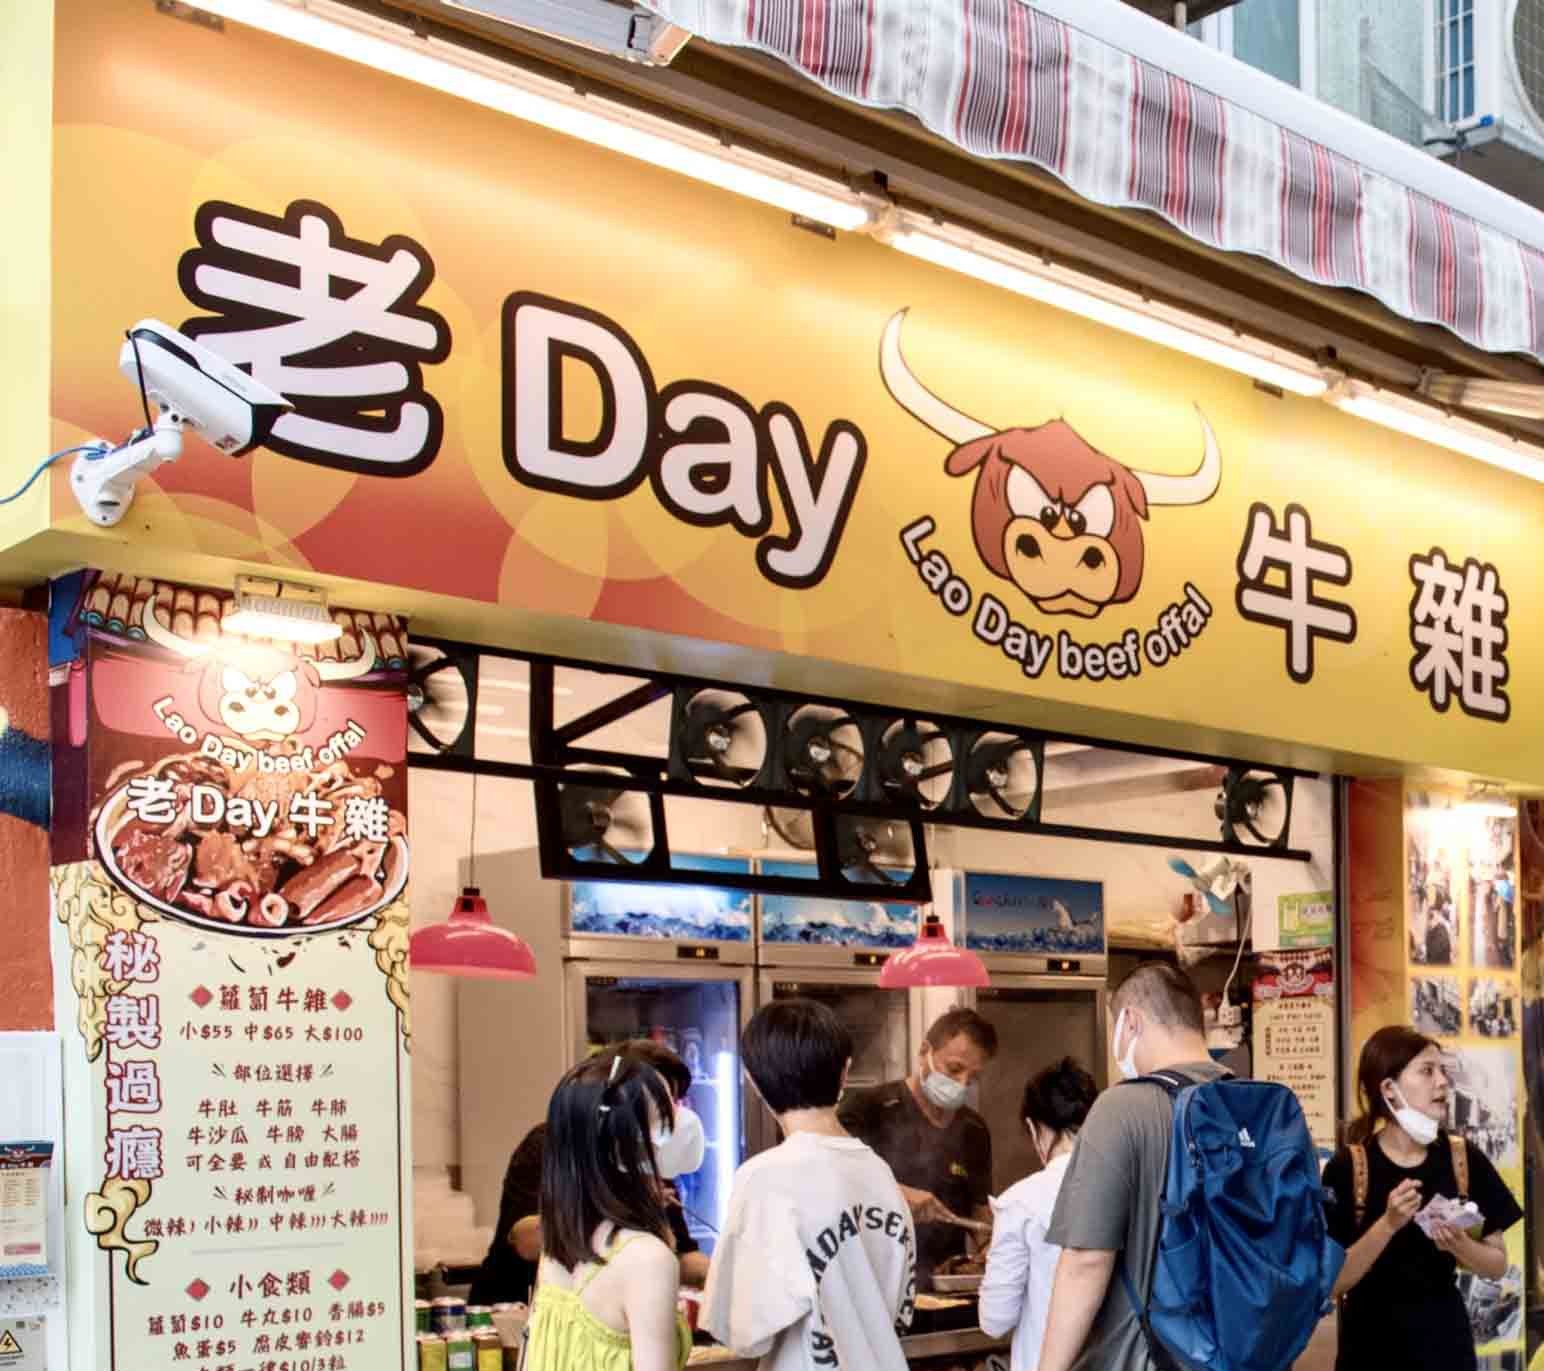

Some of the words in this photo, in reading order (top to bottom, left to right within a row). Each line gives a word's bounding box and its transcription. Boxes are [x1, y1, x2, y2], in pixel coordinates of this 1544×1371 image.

[180, 201, 450, 476] 老
[503, 292, 866, 587] Day
[1237, 505, 1510, 722] 牛雜
[901, 515, 972, 615] Lao
[972, 593, 1053, 678] Day
[1058, 630, 1140, 681] beef
[1144, 581, 1213, 667] offal
[152, 695, 197, 744] Lao
[201, 732, 253, 774] Day
[257, 746, 312, 774] beef
[318, 718, 366, 764] offal
[127, 775, 177, 825] 老
[190, 783, 278, 838] Day
[289, 790, 390, 847] 牛雜
[104, 929, 163, 1180] 秘製過癮
[180, 1021, 233, 1041] 小$55
[244, 1021, 294, 1042] 中$65
[304, 1024, 364, 1042] 大$100
[229, 1269, 312, 1300] 小食類
[240, 1306, 314, 1329] 牛丸$10
